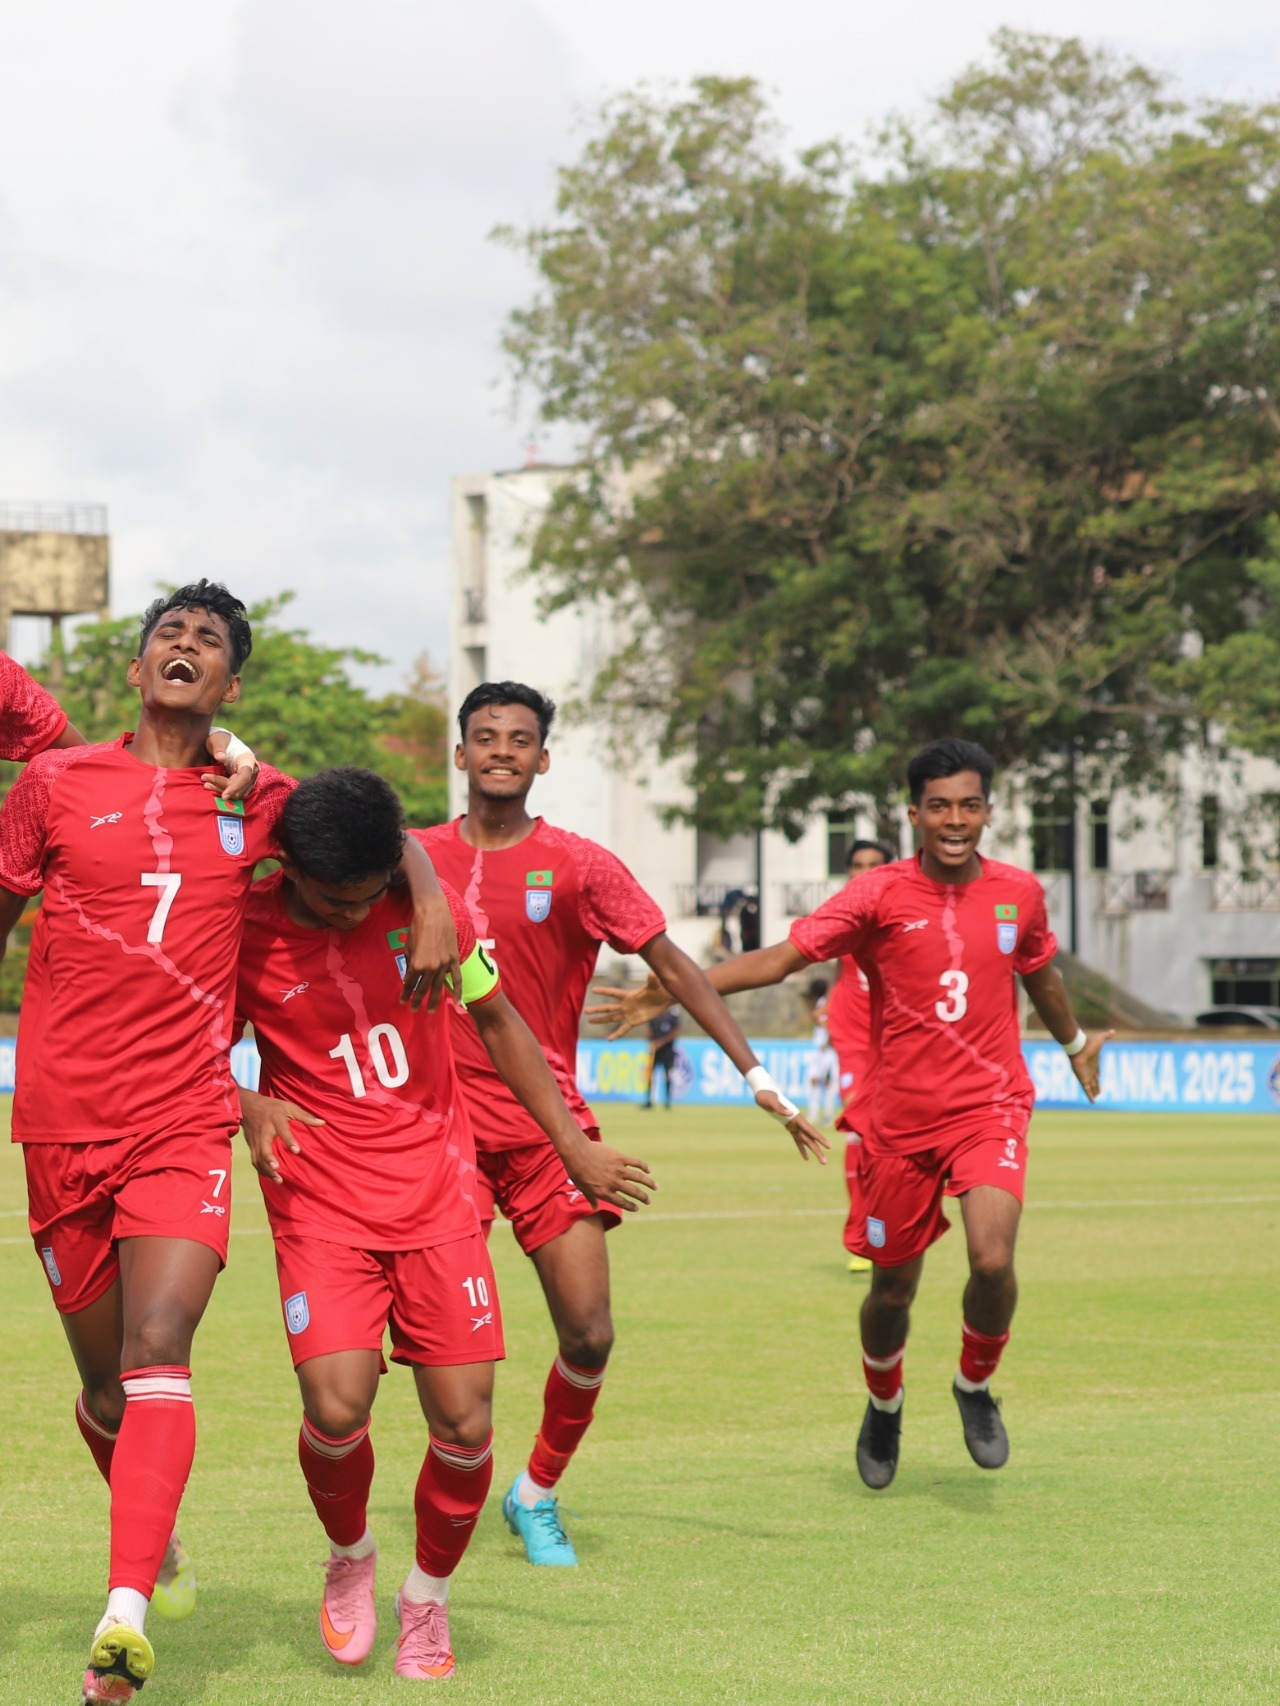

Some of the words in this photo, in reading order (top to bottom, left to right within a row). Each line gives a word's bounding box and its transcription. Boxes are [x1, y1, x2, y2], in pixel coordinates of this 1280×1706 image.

[141, 873, 182, 943] 7
[934, 969, 969, 1023] 3
[328, 1023, 410, 1099] 10
[1031, 1050, 1078, 1102] SRI
[1098, 1051, 1177, 1103] ANKA
[1183, 1052, 1255, 1104] 2025
[208, 1169, 226, 1198] 7
[461, 1276, 489, 1307] 10
